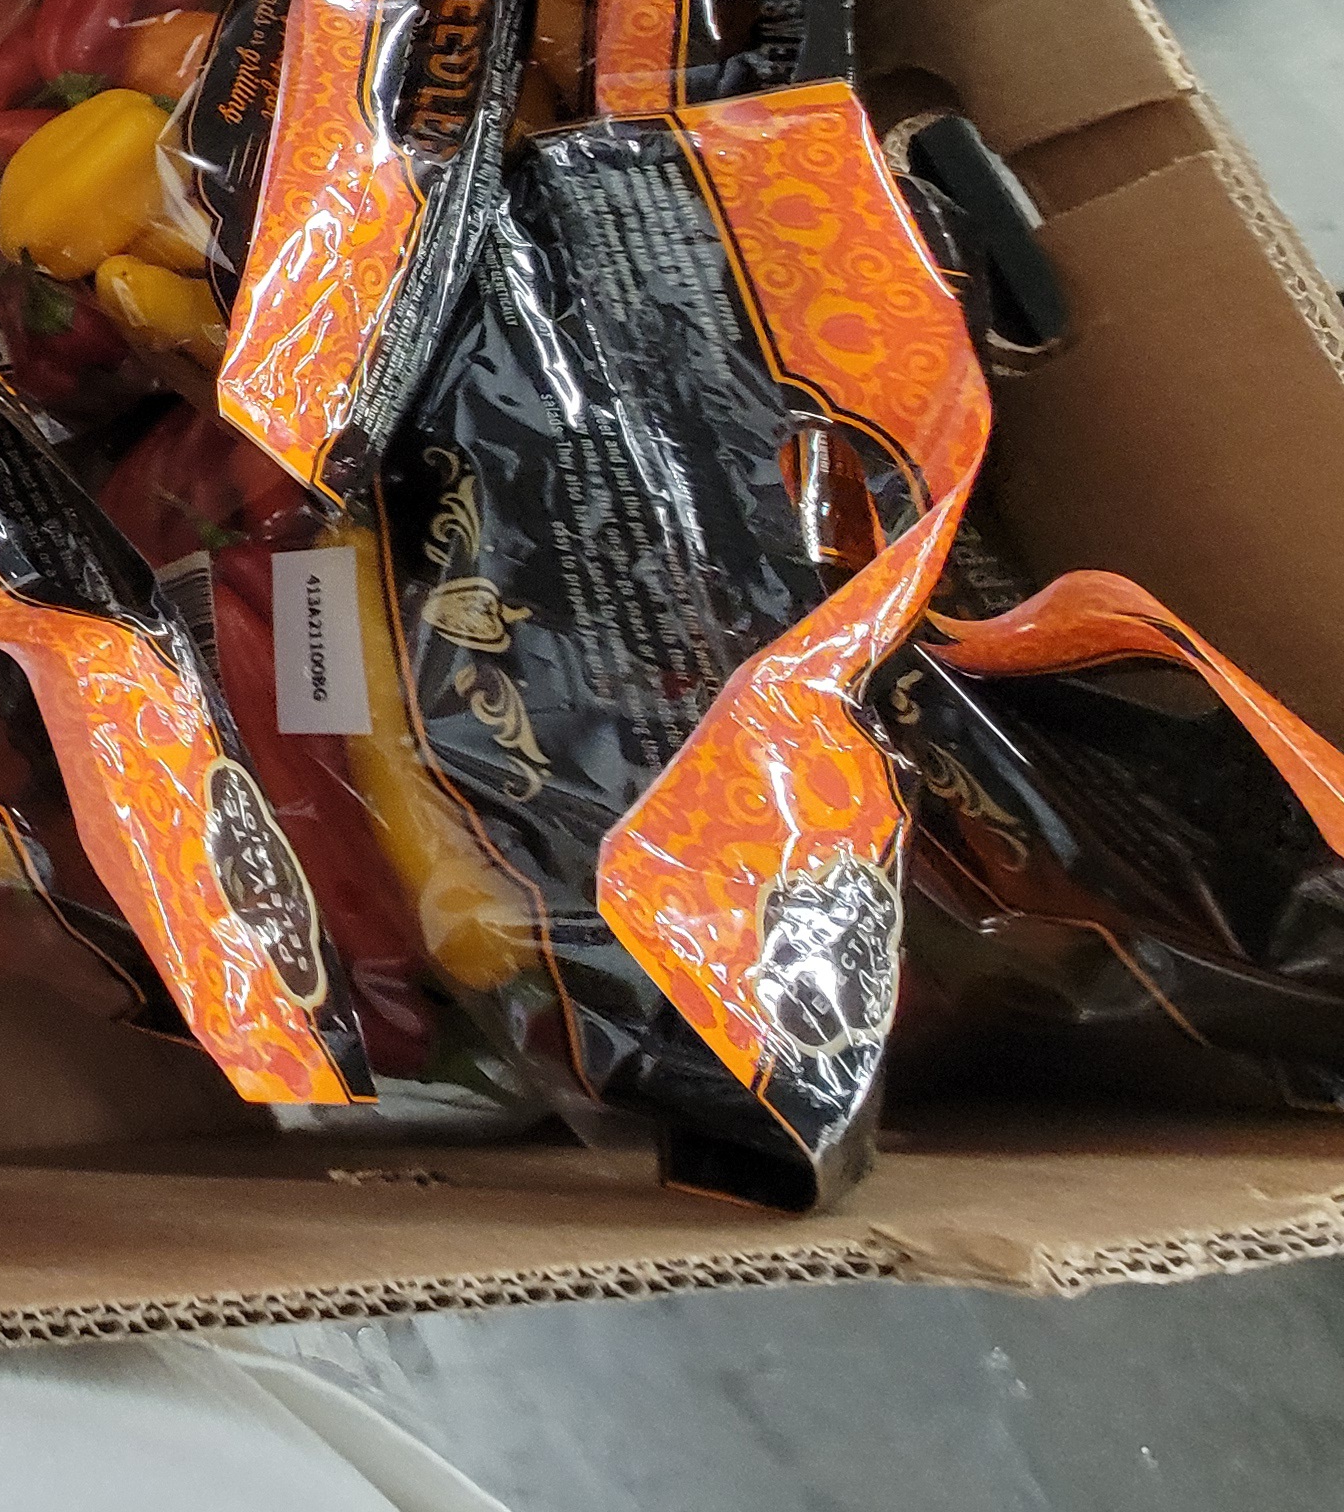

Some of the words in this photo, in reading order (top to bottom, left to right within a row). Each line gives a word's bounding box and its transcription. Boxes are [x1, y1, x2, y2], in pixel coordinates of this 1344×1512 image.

[212, 44, 268, 129] grilling
[642, 163, 673, 209] PROUDLY
[489, 268, 518, 328] GENETICALLY
[361, 385, 388, 434] PROUDLY
[540, 393, 564, 437] salads.
[555, 440, 575, 469] They
[604, 439, 621, 463] and
[563, 473, 583, 501] also
[610, 467, 636, 491] just
[622, 495, 641, 517] the
[547, 519, 573, 552] easy
[579, 438, 600, 471] make
[603, 526, 638, 596] on-the-go
[623, 599, 651, 640] snack
[640, 642, 659, 659] or
[559, 554, 576, 569] to
[586, 560, 612, 601] seeds
[669, 647, 693, 683] their
[621, 683, 651, 735] making
